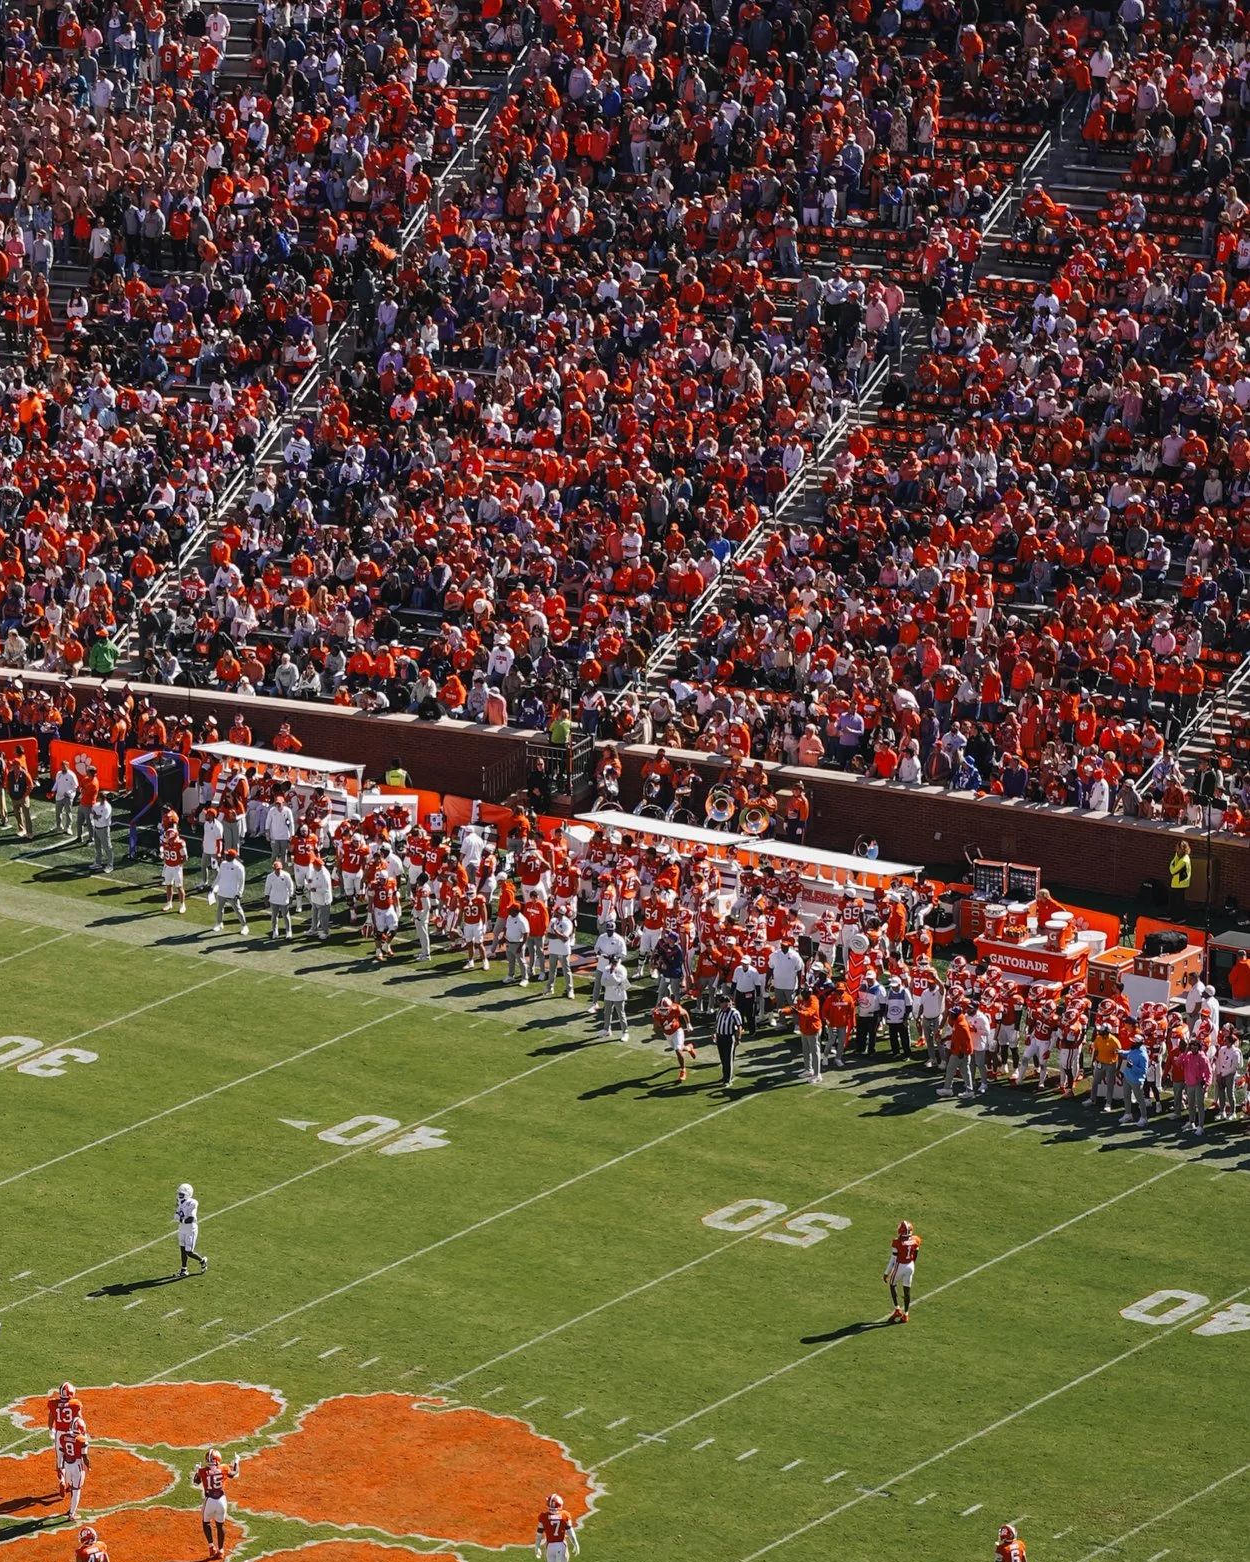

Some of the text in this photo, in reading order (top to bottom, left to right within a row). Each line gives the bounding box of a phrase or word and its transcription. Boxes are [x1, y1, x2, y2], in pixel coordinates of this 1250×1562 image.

[163, 52, 170, 62] 6
[219, 113, 225, 123] 9
[961, 237, 968, 249] 3
[269, 302, 275, 313] 7
[969, 393, 979, 404] 16
[1172, 502, 1178, 514] 2
[163, 850, 176, 860] 99
[349, 853, 359, 864] 71
[556, 876, 568, 886] 94
[465, 905, 478, 917] 33
[644, 909, 658, 920] 54
[843, 907, 859, 919] 89
[985, 920, 992, 929] G
[1008, 915, 1014, 924] G
[1049, 933, 1056, 941] G
[989, 952, 1050, 974] GATORADE
[914, 977, 926, 988] 50
[1035, 1024, 1048, 1035] 35
[316, 1112, 450, 1155] 40
[700, 1197, 851, 1247] 50
[906, 1245, 911, 1258] 1
[55, 1406, 72, 1421] 13
[64, 1441, 74, 1456] 8
[206, 1474, 222, 1489] 15
[550, 1520, 560, 1536] 7
